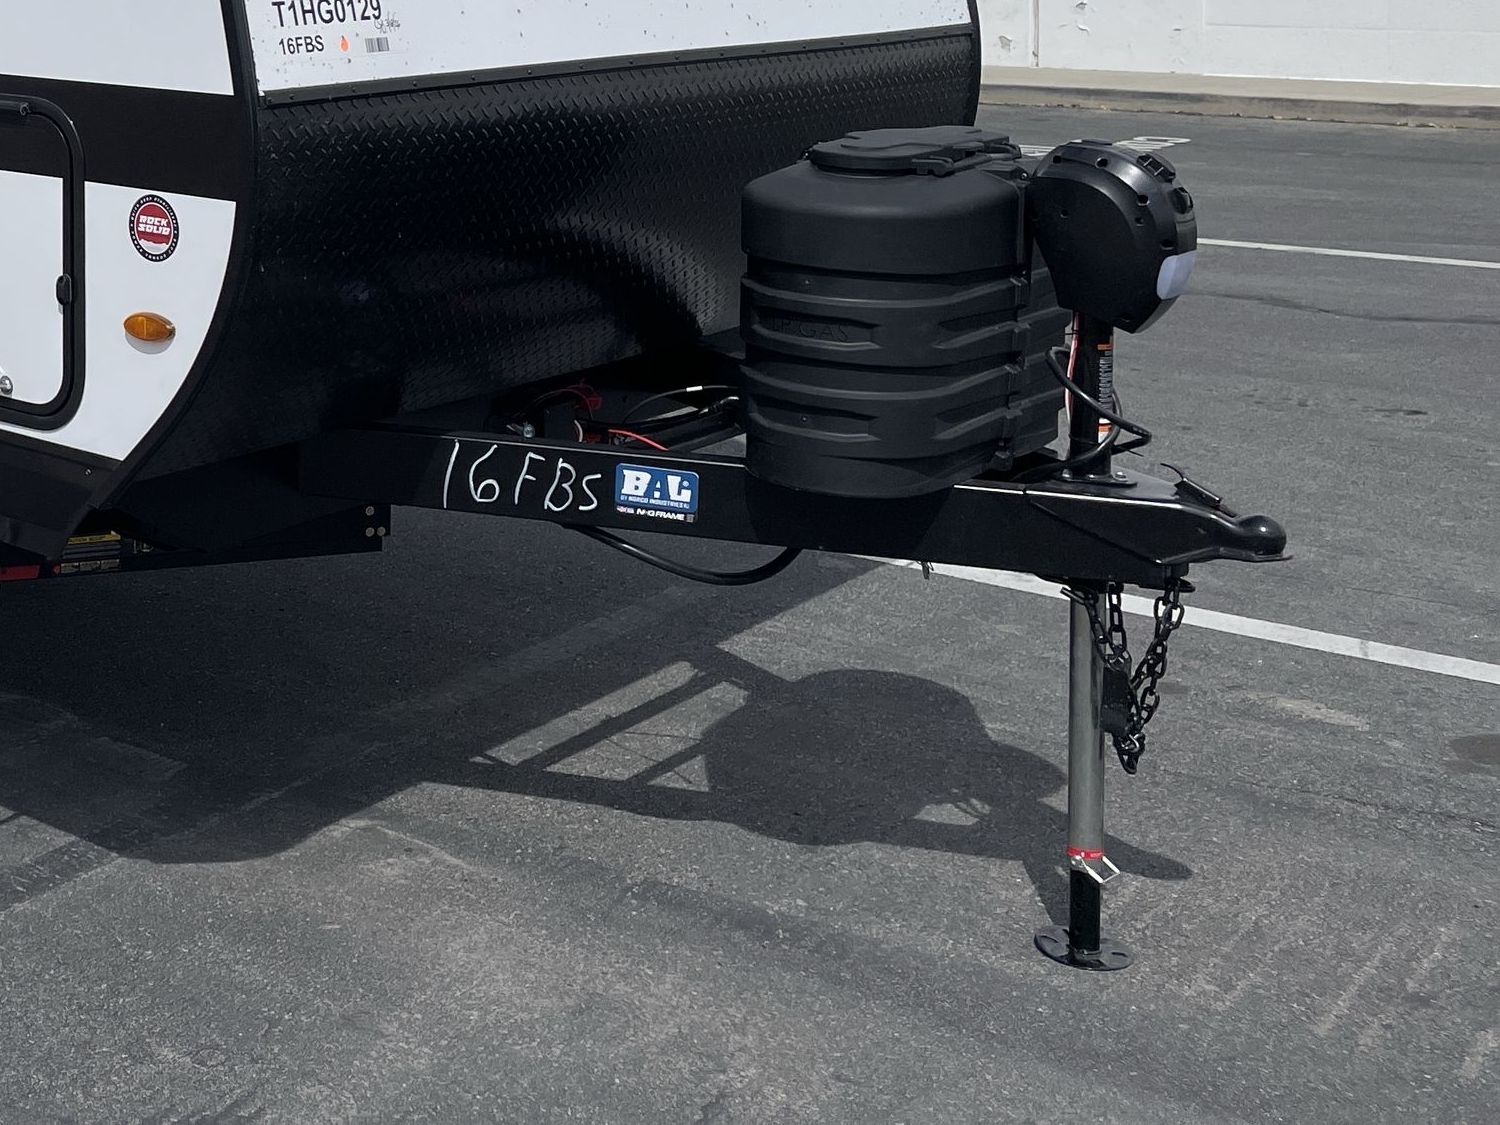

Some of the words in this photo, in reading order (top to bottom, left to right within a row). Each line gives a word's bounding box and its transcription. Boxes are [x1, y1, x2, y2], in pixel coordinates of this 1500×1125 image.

[278, 35, 325, 55] 16FBS
[139, 214, 169, 227] ROCK
[137, 223, 171, 236] SOLID
[621, 469, 692, 503] BAL
[655, 510, 685, 521] FRAME
